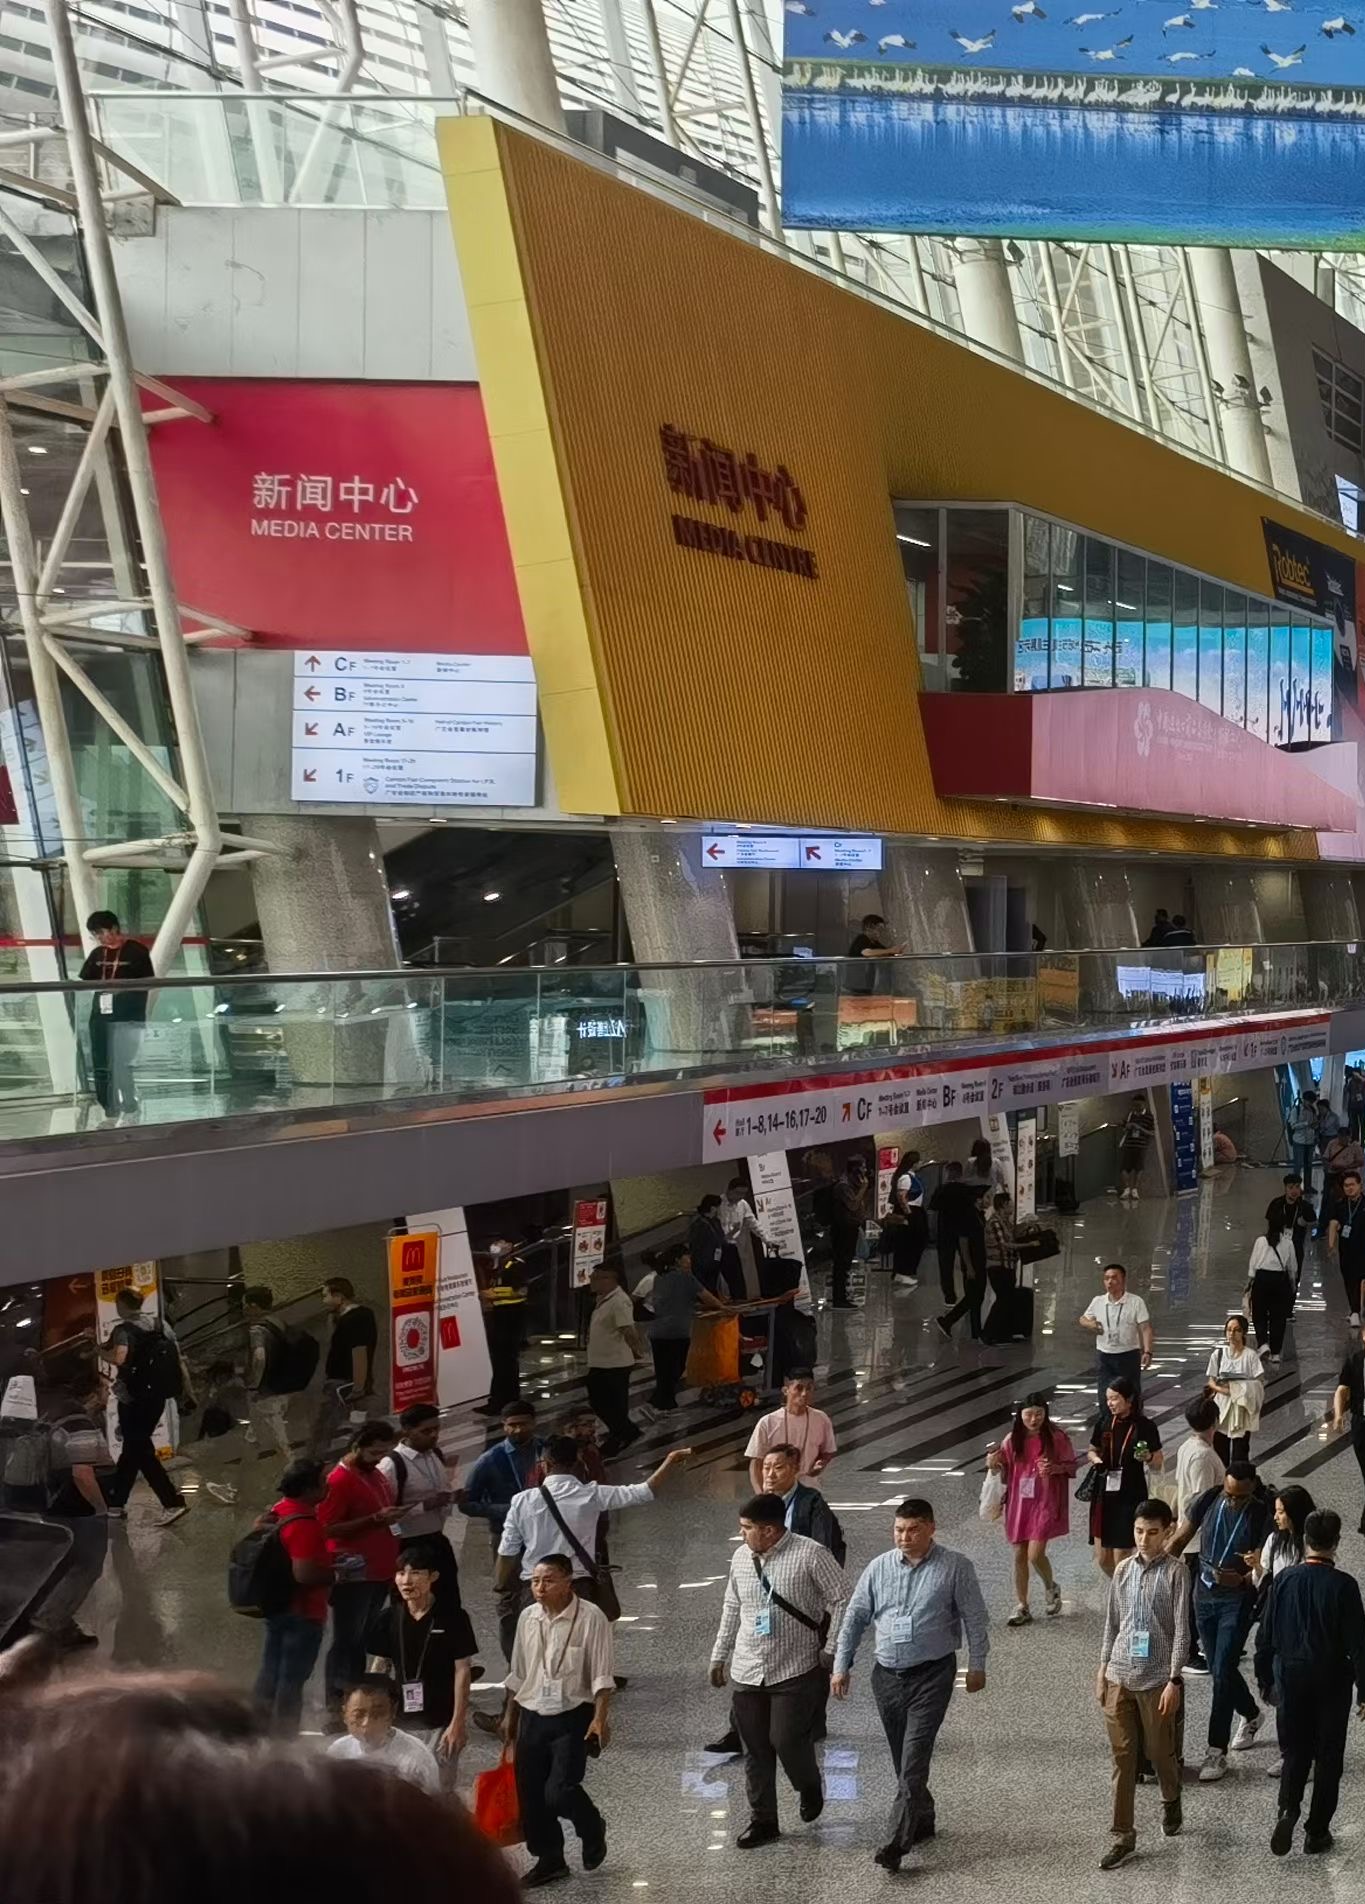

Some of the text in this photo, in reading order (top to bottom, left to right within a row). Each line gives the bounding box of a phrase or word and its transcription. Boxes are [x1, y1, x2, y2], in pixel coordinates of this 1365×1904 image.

[660, 422, 808, 532] 新闻中心
[252, 472, 419, 514] 新闻中心
[251, 519, 413, 542] MEDIA CENTER
[671, 514, 746, 561] MEDIA
[1272, 544, 1312, 587] Robtec
[334, 656, 357, 672] CF
[334, 687, 356, 702] BF
[333, 723, 355, 737] AF
[336, 769, 354, 783] 1F
[943, 1085, 956, 1107] BF
[991, 1078, 1004, 1099] 2F
[857, 1097, 872, 1121] CF
